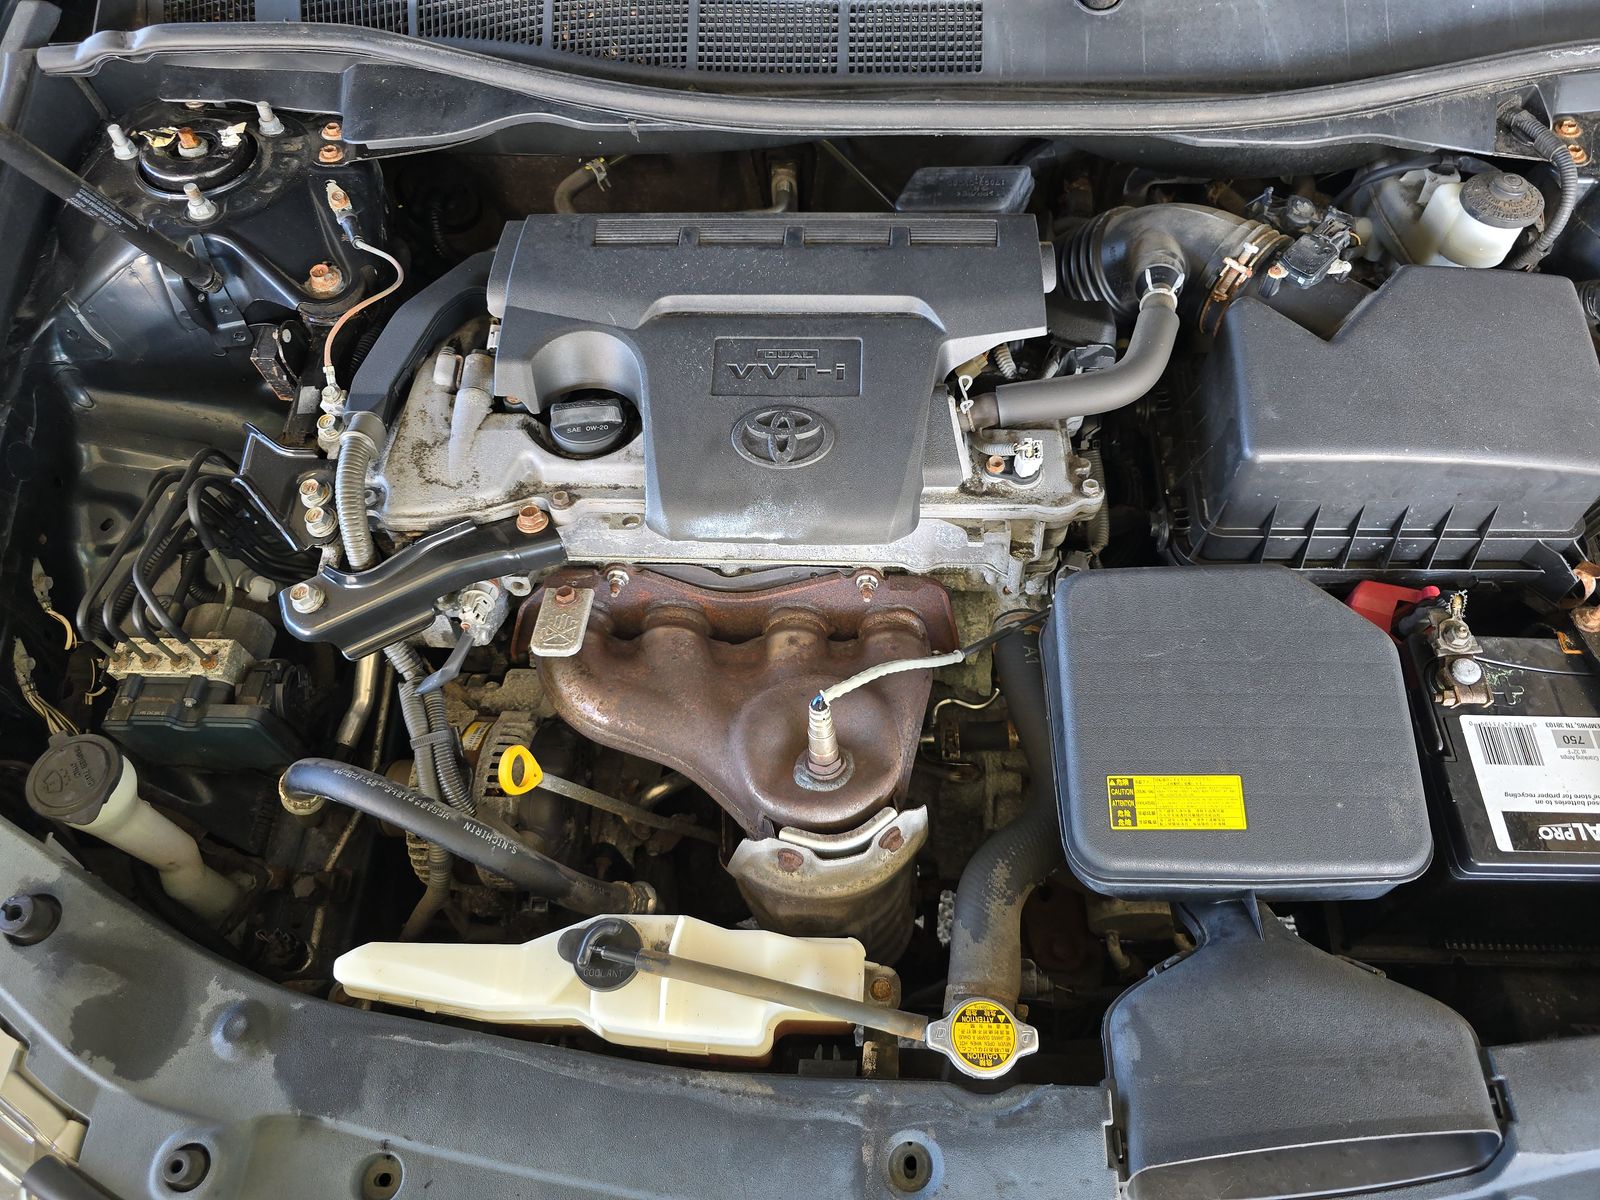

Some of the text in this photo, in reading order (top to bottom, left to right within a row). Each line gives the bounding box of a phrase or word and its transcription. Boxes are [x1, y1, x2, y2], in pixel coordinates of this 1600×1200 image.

[764, 351, 814, 359] DUAL
[726, 363, 846, 381] VVT-i
[566, 424, 609, 434] SAE 0W-20
[1562, 735, 1585, 745] 750
[1110, 788, 1134, 796] CAUTION
[1112, 799, 1136, 807] ATTENTION
[583, 968, 623, 978] COOLANT
